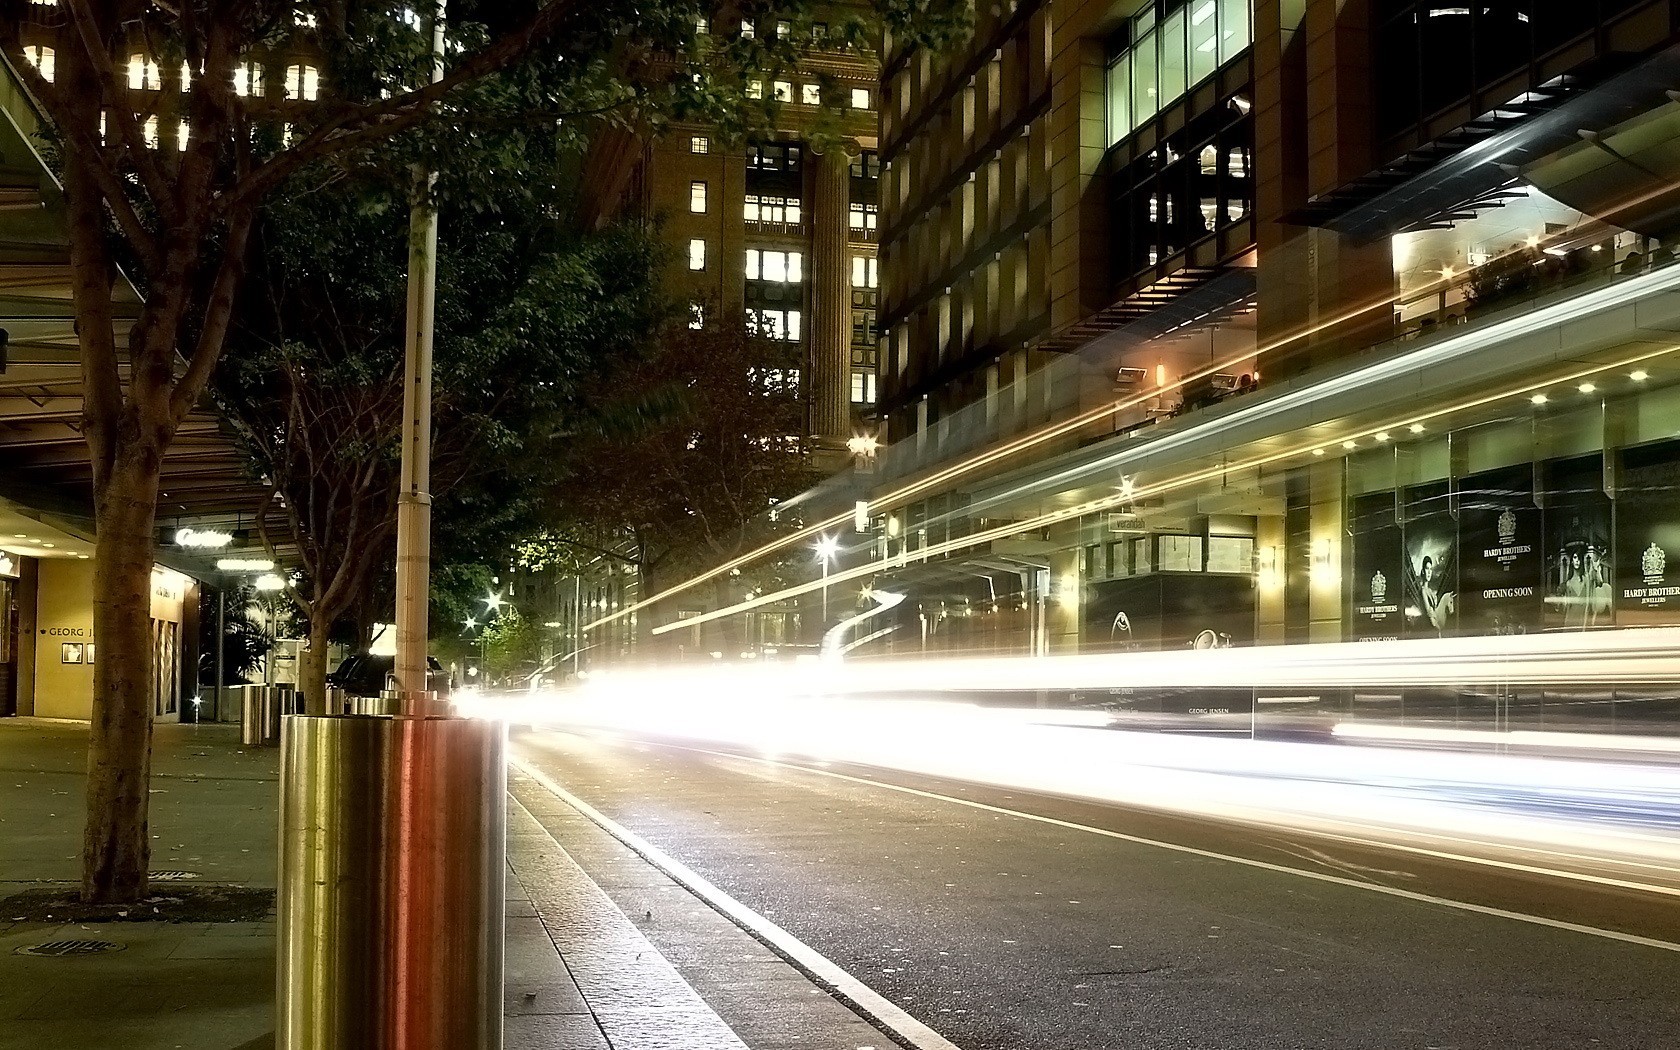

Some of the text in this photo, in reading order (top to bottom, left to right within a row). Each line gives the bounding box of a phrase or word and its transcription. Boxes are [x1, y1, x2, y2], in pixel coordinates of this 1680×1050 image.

[1117, 518, 1145, 528] verandah
[1484, 545, 1531, 557] HARDY BROTHERS
[1483, 587, 1532, 598] OPENING SOON
[1624, 587, 1680, 597] HARDY BROTHER
[50, 628, 84, 636] GEORG
[1209, 708, 1230, 716] JENSEN
